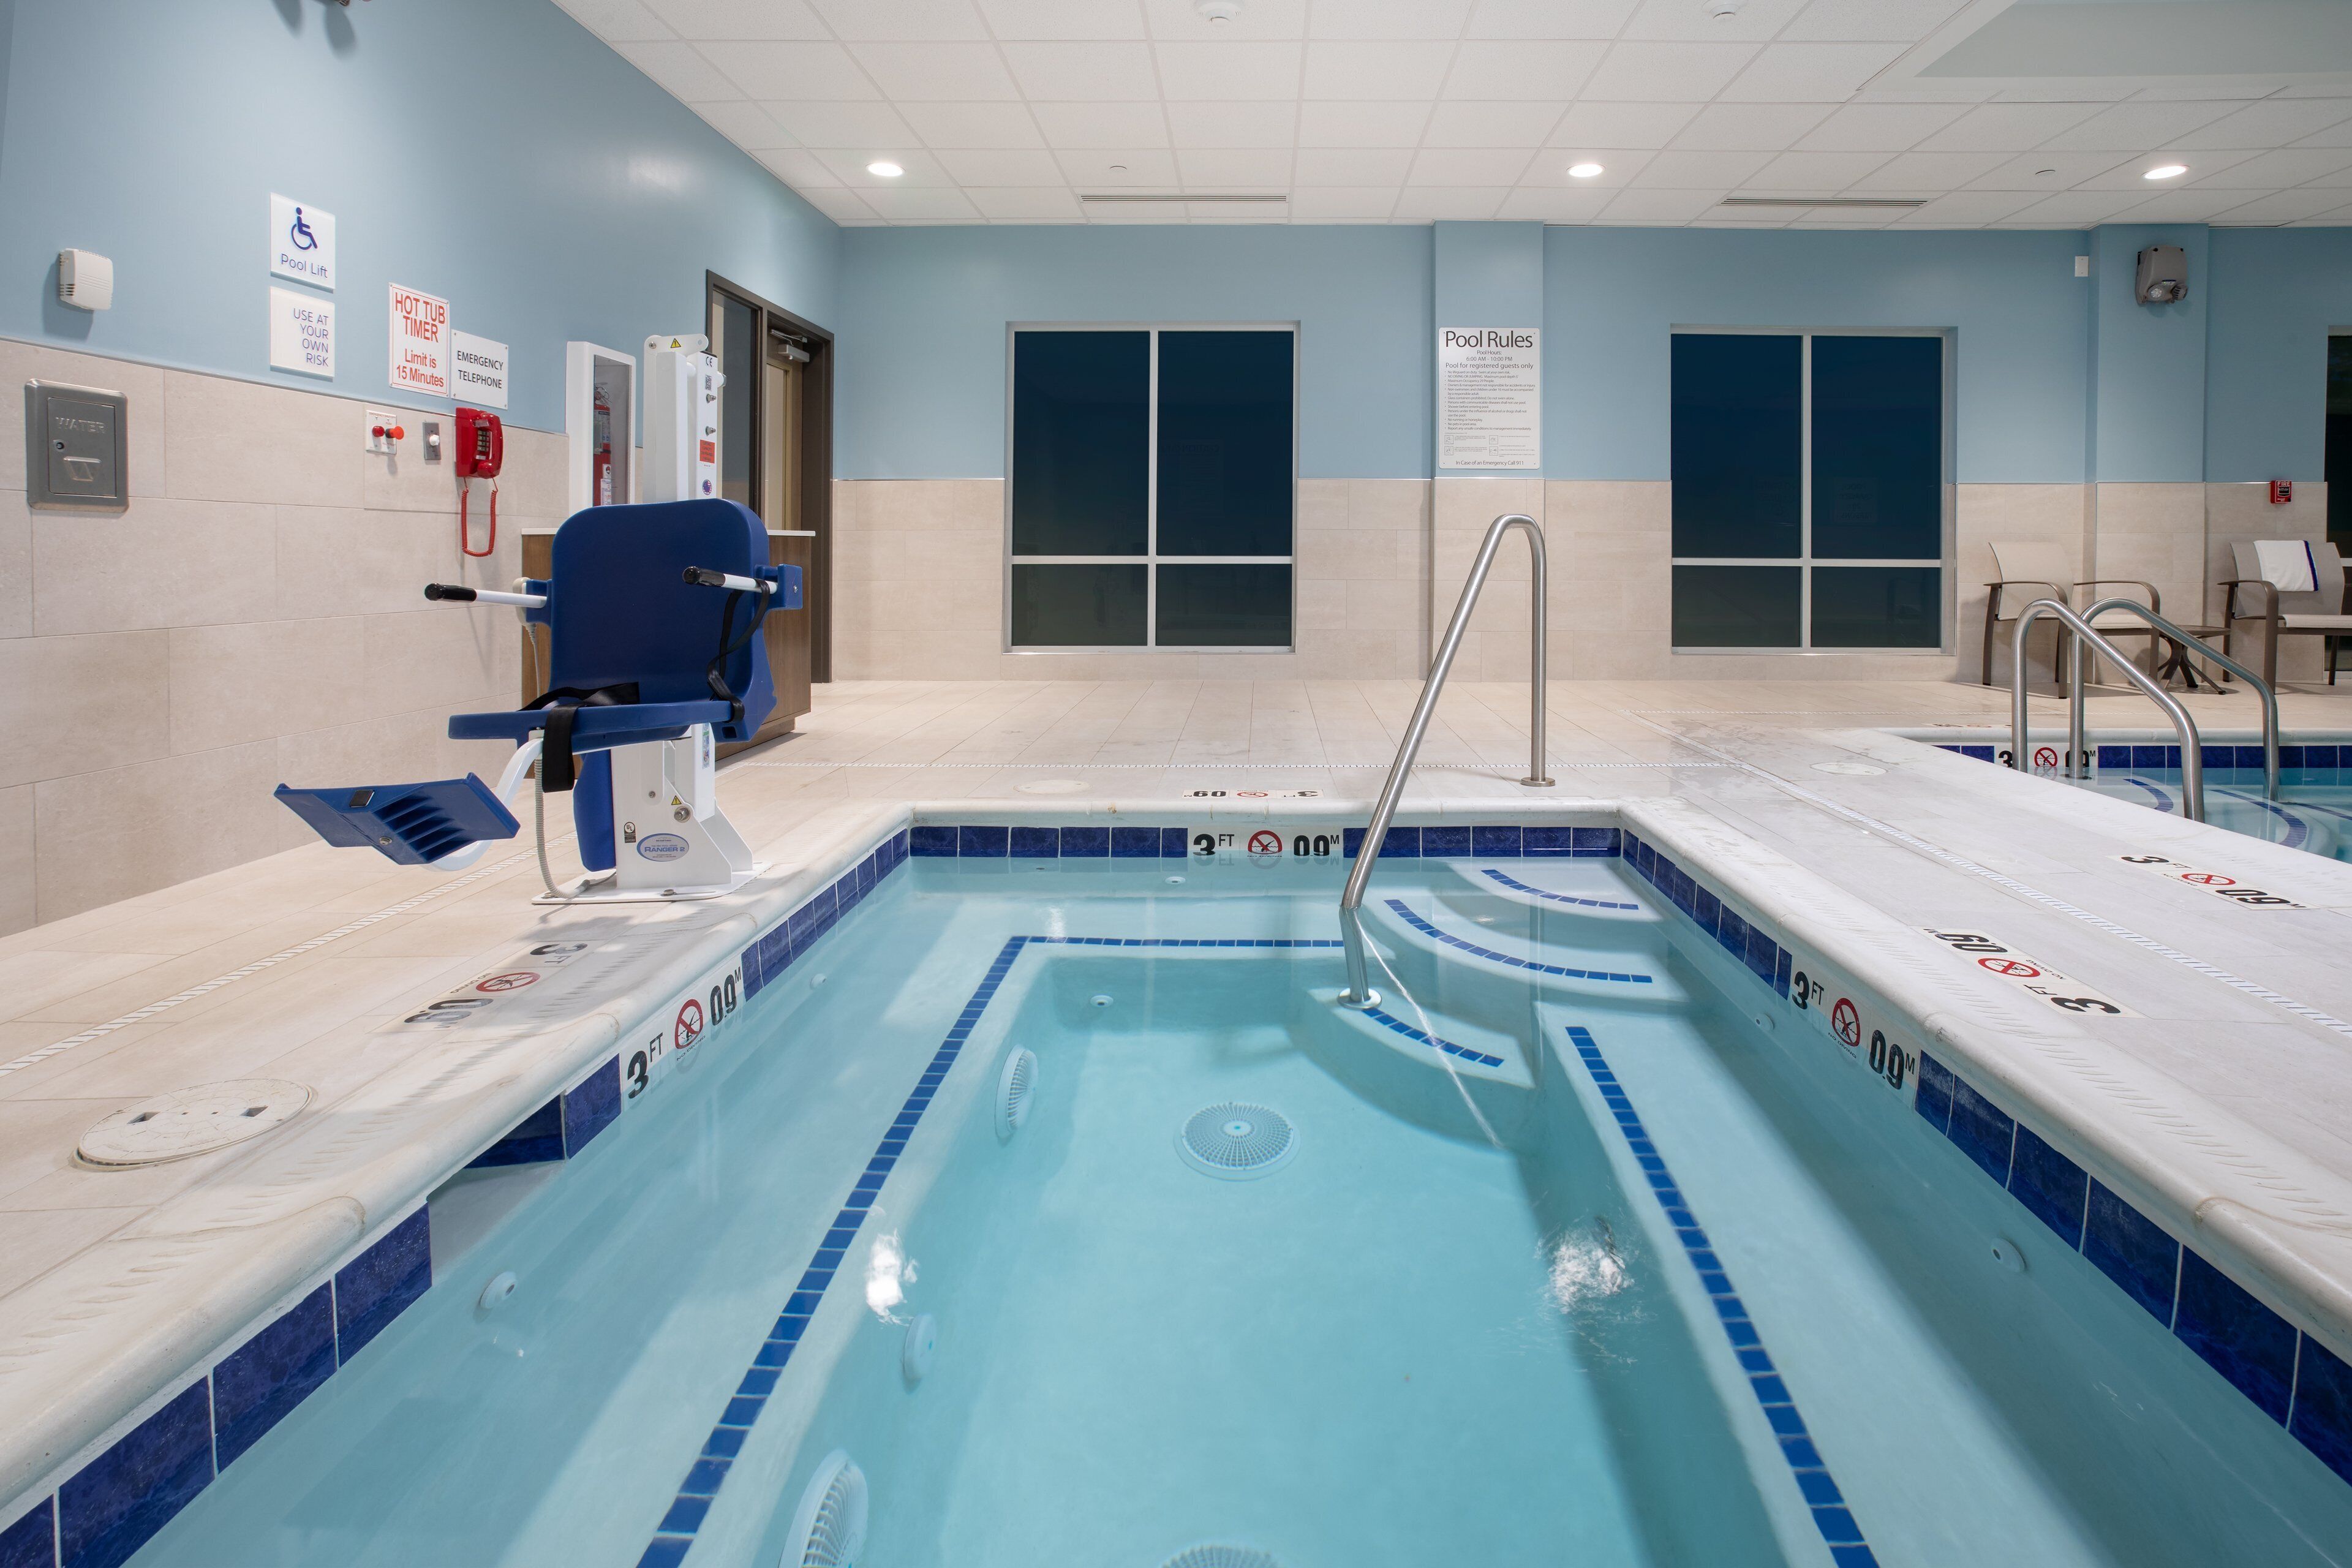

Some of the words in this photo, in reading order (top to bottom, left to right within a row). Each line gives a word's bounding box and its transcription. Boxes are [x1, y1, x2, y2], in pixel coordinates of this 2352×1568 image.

[281, 254, 306, 271] Pool
[311, 263, 327, 278] Lift
[294, 308, 313, 322] USE
[317, 315, 328, 325] AT
[395, 292, 420, 317] HOT
[423, 300, 445, 324] TUB
[300, 323, 328, 339] YOUR
[403, 315, 439, 343] TIMER
[302, 339, 328, 353] OWN
[1446, 331, 1482, 347] Pool
[1488, 331, 1533, 347] Rules
[306, 353, 328, 367] RISK
[405, 348, 427, 366] Limit
[429, 354, 436, 368] is
[457, 350, 503, 371] EMERGENCY
[706, 356, 712, 367] CE
[397, 365, 407, 380] 15
[410, 367, 444, 387] Minutes
[458, 370, 502, 388] TELEPHONE
[55, 417, 105, 434] WATER
[1193, 834, 1216, 856] 3
[1219, 834, 1235, 847] FT
[1330, 835, 1339, 845] M
[2215, 889, 2291, 904] 0.9
[530, 943, 588, 955] 3
[1934, 934, 2008, 953] 0.9
[544, 955, 572, 964] FT
[710, 974, 737, 1026] 0.9
[734, 966, 741, 983] M
[1792, 971, 1809, 1010] 3
[1811, 980, 1824, 1005] FT
[2023, 984, 2057, 995] FT
[404, 998, 494, 1023] 0.9
[2050, 997, 2121, 1014] 3
[677, 1052, 686, 1061] NO
[687, 1035, 705, 1053] DIVING
[1828, 1032, 1836, 1040] NO
[1838, 1041, 1856, 1059] DIVING
[628, 1050, 649, 1099] 3
[650, 1032, 663, 1062] FT
[1869, 1029, 1904, 1090] 0.9
[1905, 1052, 1915, 1075] M
